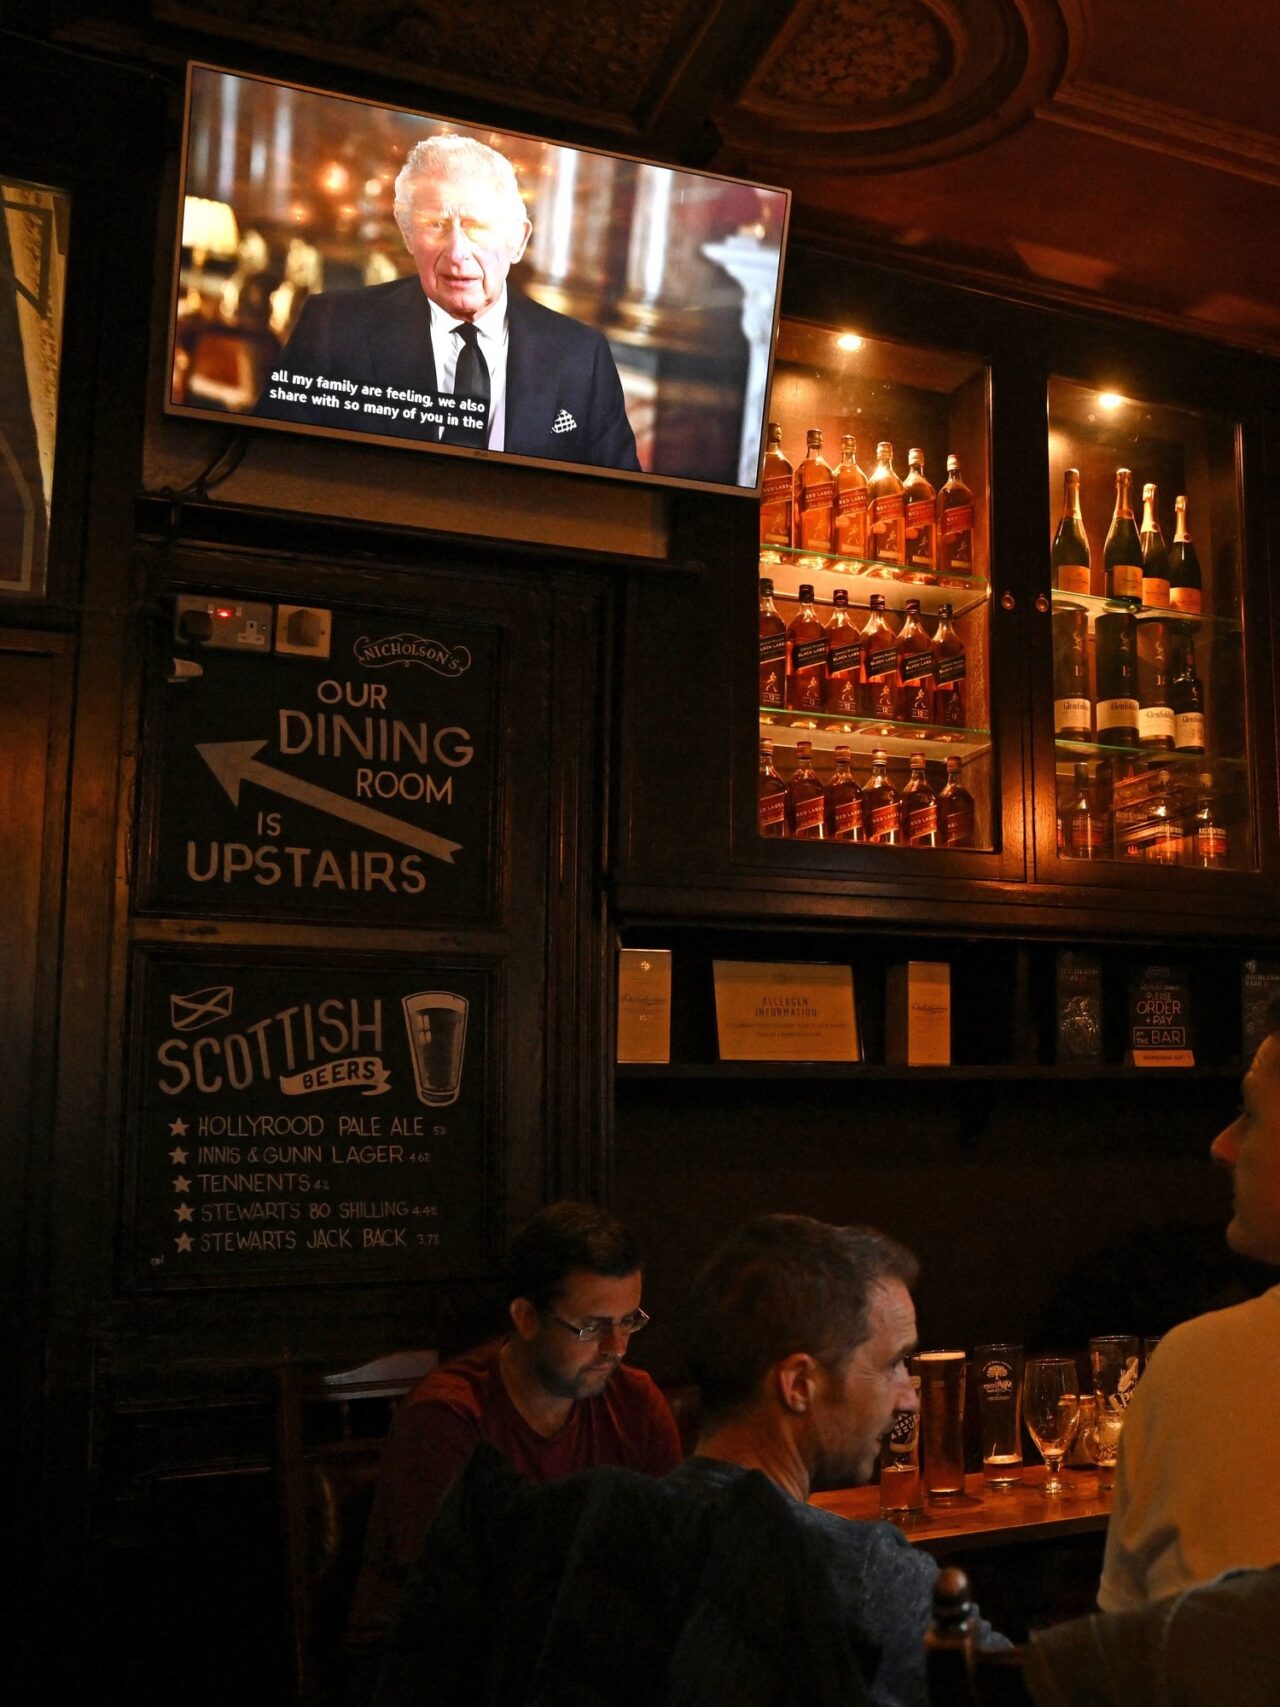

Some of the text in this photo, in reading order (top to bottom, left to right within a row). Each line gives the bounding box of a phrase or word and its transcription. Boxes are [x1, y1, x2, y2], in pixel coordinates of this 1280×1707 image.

[271, 369, 485, 413] all my family are feeling, we also
[269, 387, 484, 429] share with so many of you in the
[817, 489, 833, 497] LABEL
[363, 642, 463, 672] NICHOLSON'S
[317, 680, 387, 710] OUR
[279, 708, 475, 768] DINING
[356, 767, 453, 805] ROOM
[257, 811, 281, 837] IS
[186, 840, 427, 894] UPSTAIRS
[755, 1008, 817, 1017] INFORMATION
[762, 997, 809, 1006] ALLERGEN
[1136, 1000, 1181, 1015] ORDER
[1152, 1015, 1173, 1025] PAY
[157, 997, 383, 1096] SCOTTISH
[1151, 1030, 1181, 1044] BAR
[302, 1060, 377, 1090] BEERS
[198, 1115, 325, 1137] HOLLYROOD
[338, 1116, 381, 1137] PALE
[390, 1116, 425, 1137] ALE
[199, 1146, 241, 1165] INNIS
[247, 1146, 258, 1164] &
[263, 1145, 322, 1165] GUNN
[332, 1145, 405, 1164] LAGER
[197, 1172, 311, 1193] TENNENTS
[200, 1201, 301, 1223] STEWARTS
[309, 1202, 331, 1220] 80
[338, 1200, 409, 1220] SHILLING
[200, 1230, 297, 1253] STEWARTS
[306, 1227, 352, 1249] JACK
[363, 1227, 408, 1249] BACK
